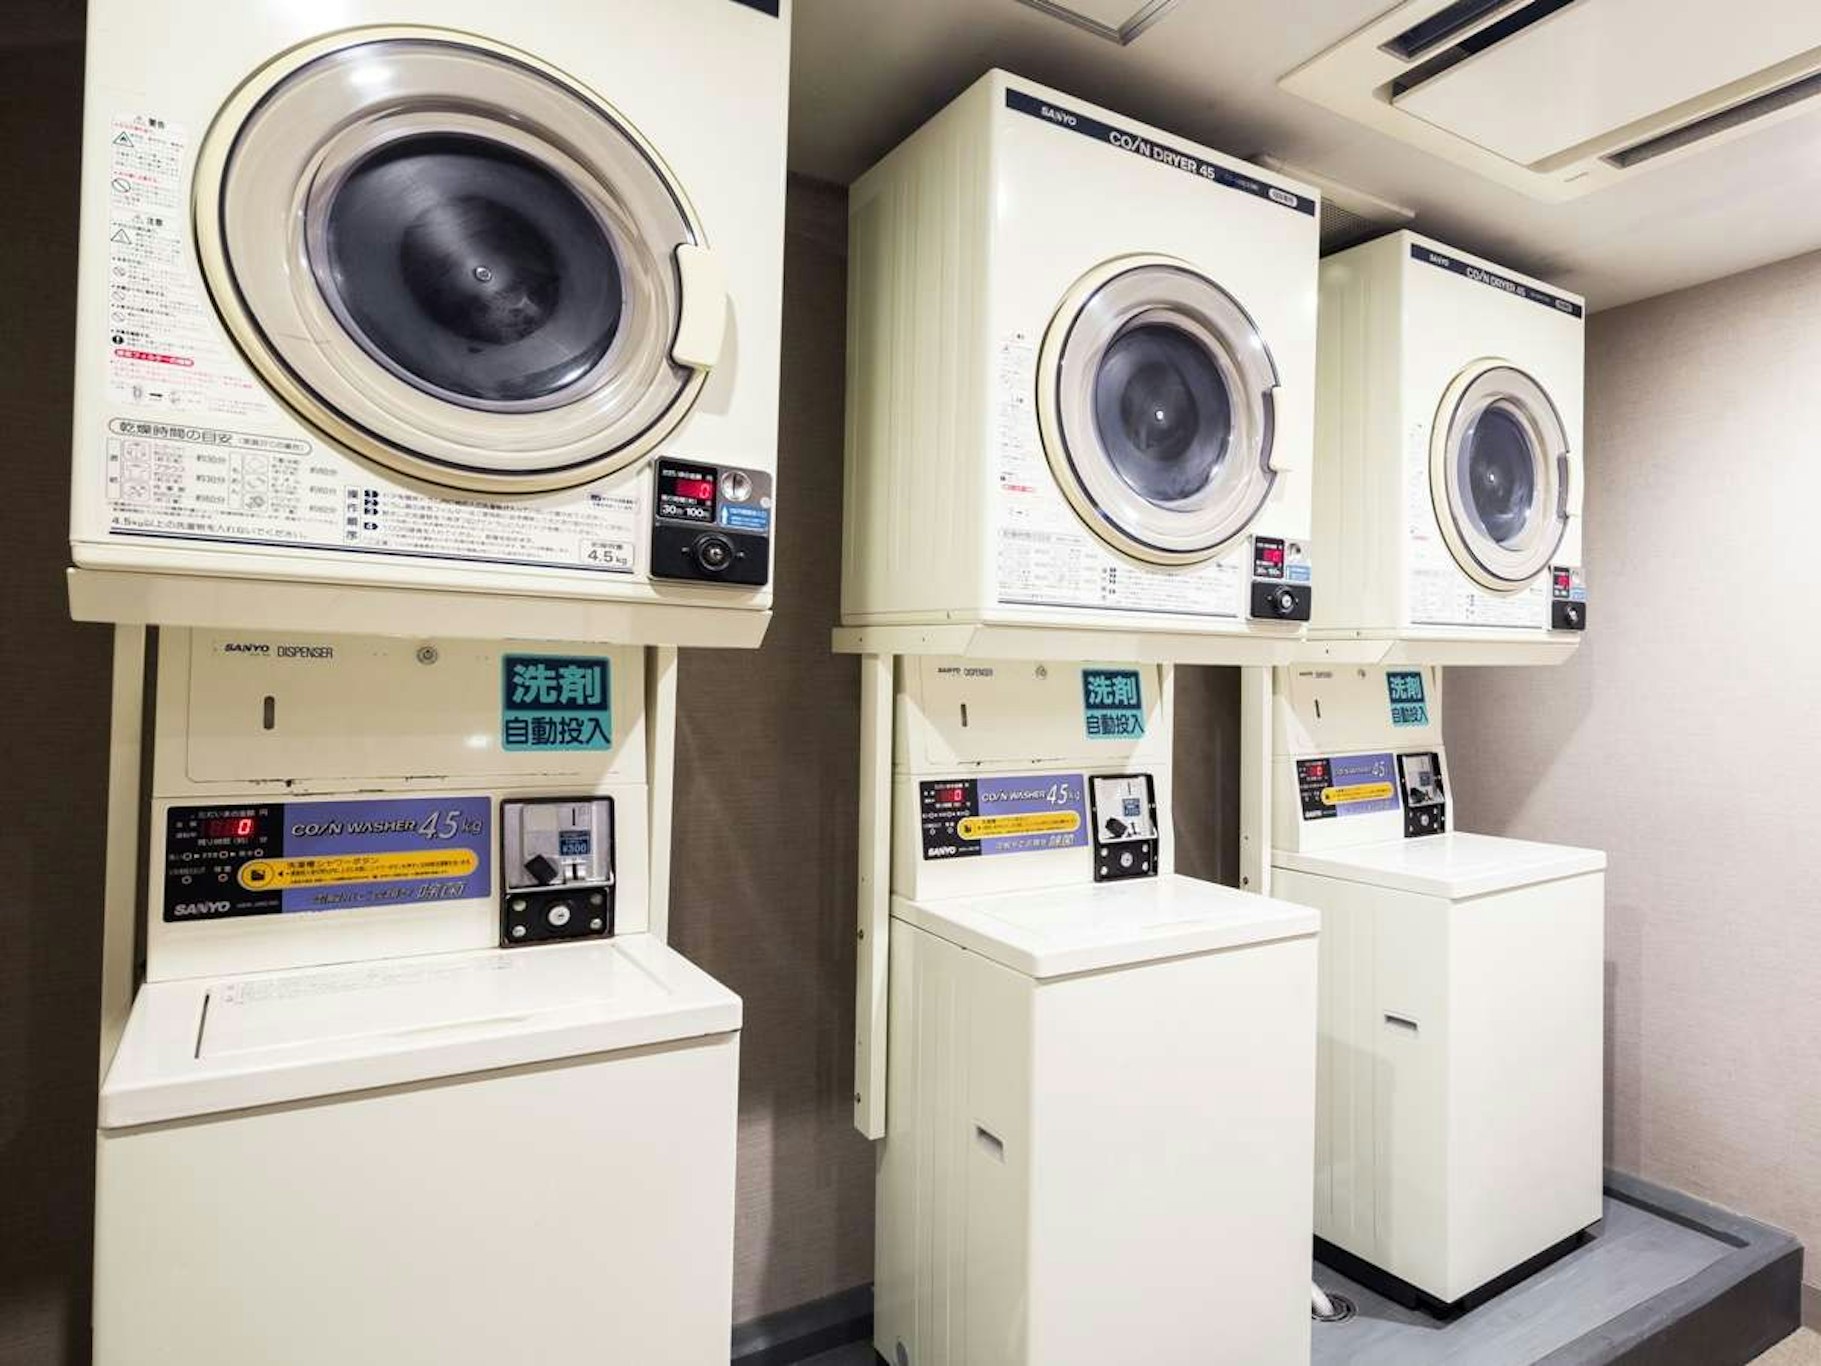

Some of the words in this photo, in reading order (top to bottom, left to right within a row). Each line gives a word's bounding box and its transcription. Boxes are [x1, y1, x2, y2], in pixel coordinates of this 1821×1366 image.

[1041, 106, 1078, 127] SANYO
[1152, 147, 1198, 173] DRYER
[1200, 165, 1216, 180] 45
[119, 421, 233, 445] 乾燥時間の目安
[587, 550, 614, 563] 4.5
[224, 643, 270, 652] SANYO
[277, 646, 333, 659] DISPENSER
[512, 664, 602, 706] 洗剤
[1088, 675, 1138, 706] 洗剤
[1391, 677, 1422, 699] 洗剤
[505, 716, 611, 745] 自動投入
[1086, 715, 1145, 736] 自動投入
[238, 819, 251, 835] 0
[347, 820, 416, 834] WASHER
[461, 818, 482, 835] kg
[174, 901, 231, 916] SANYO
